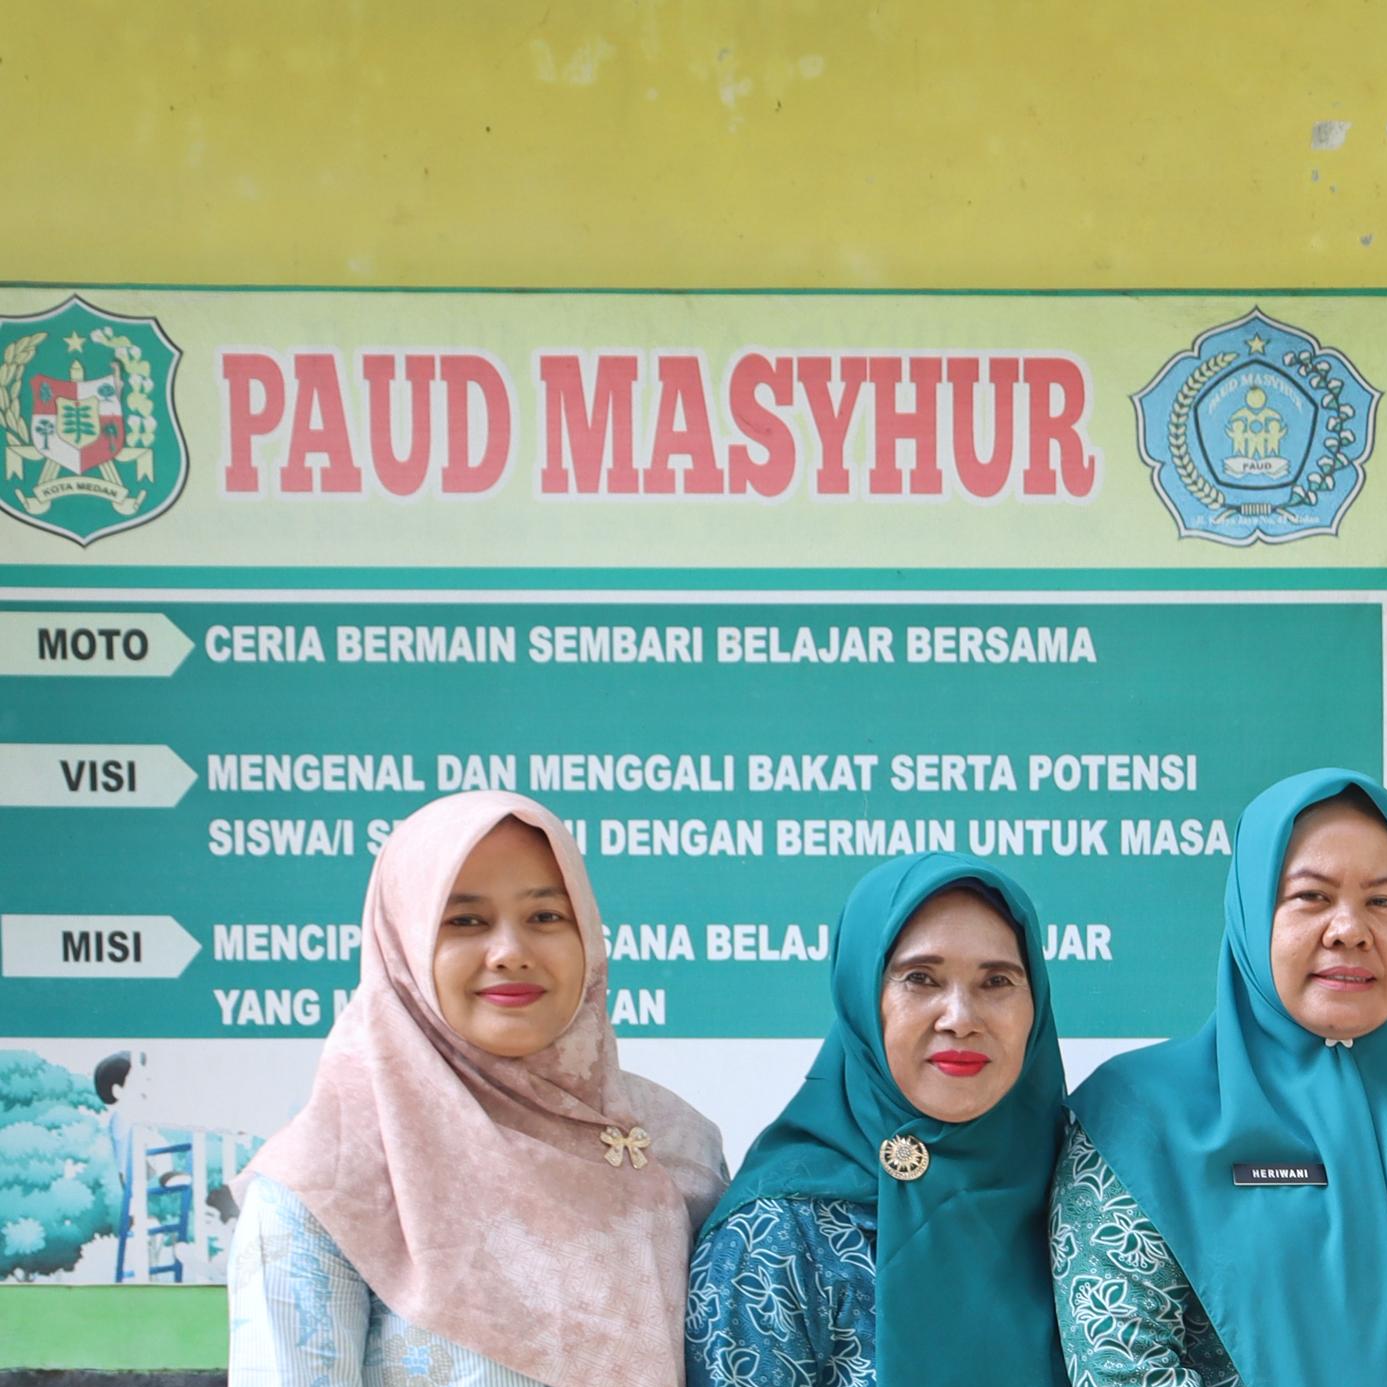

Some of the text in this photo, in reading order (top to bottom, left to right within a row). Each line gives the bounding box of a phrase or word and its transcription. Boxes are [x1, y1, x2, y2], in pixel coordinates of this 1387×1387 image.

[220, 352, 1096, 498] PAUD MASYHUR
[1242, 462, 1273, 472] PAUD
[43, 482, 118, 497] KOTA MEDAN
[37, 627, 149, 662] MOTO
[204, 625, 1098, 664] CERIA BERMAIN SEMBARI BELAJAR BERSAMA
[60, 759, 137, 793] VISI
[207, 754, 1197, 792] MENGENAL DAN MENGGALI BAKAT SERTA POTENSI
[208, 819, 355, 856] SISWA/I
[601, 819, 764, 856] DENGAN
[777, 819, 960, 856] BERMAIN
[969, 819, 1108, 856] UNTUK
[1120, 819, 1233, 856] MASA
[62, 930, 143, 963] MISI
[213, 923, 363, 961] MENCIP
[706, 924, 831, 961] BELAJ
[213, 989, 321, 1026] YANG
[1252, 1168, 1309, 1179] HERIWANI
